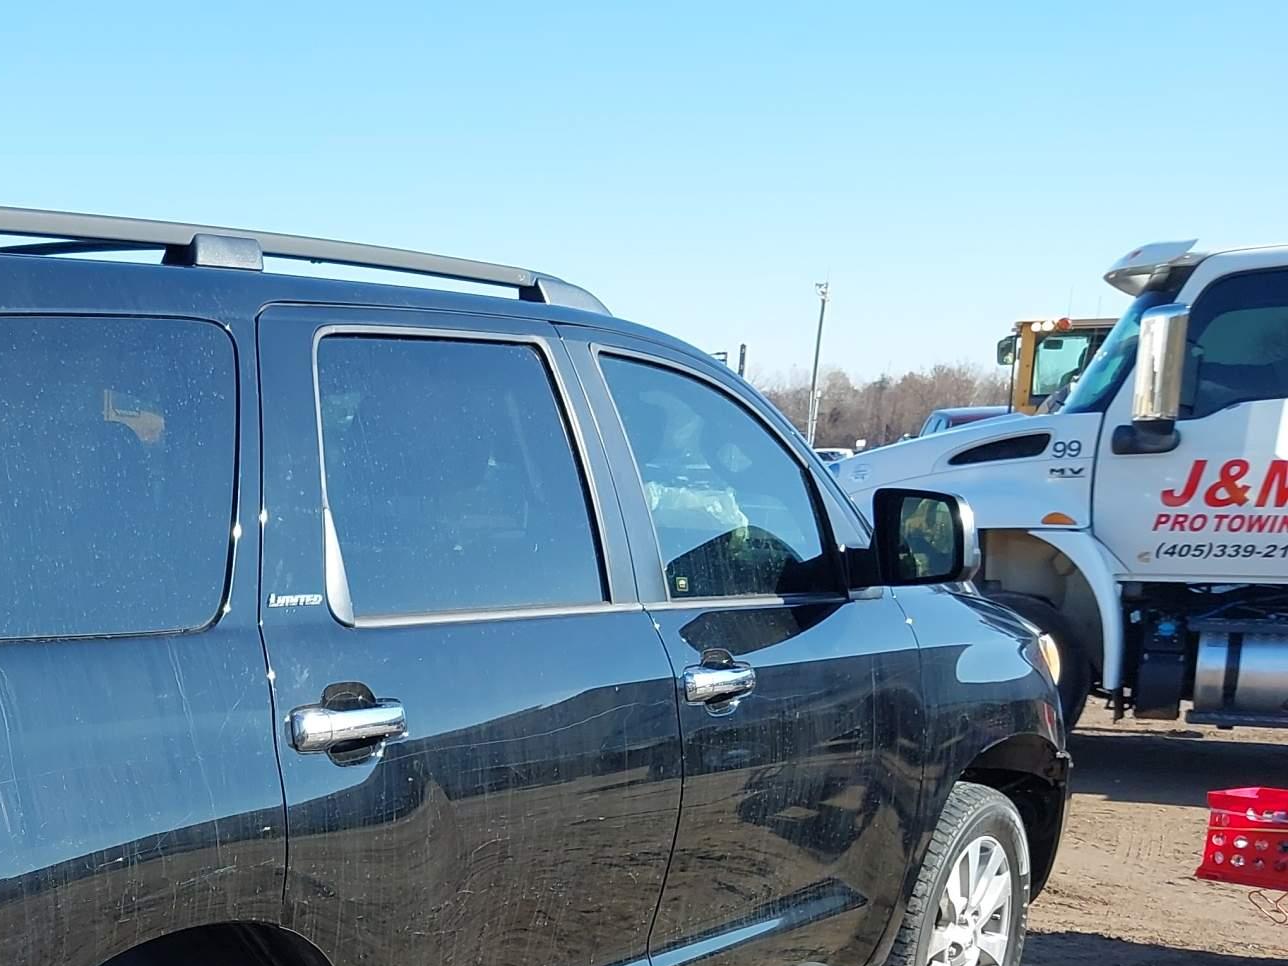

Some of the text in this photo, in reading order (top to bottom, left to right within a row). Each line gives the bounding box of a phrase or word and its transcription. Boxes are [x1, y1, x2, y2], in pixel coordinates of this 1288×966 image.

[1052, 440, 1082, 459] 99
[1049, 467, 1085, 475] MV
[1152, 513, 1209, 532] PRO
